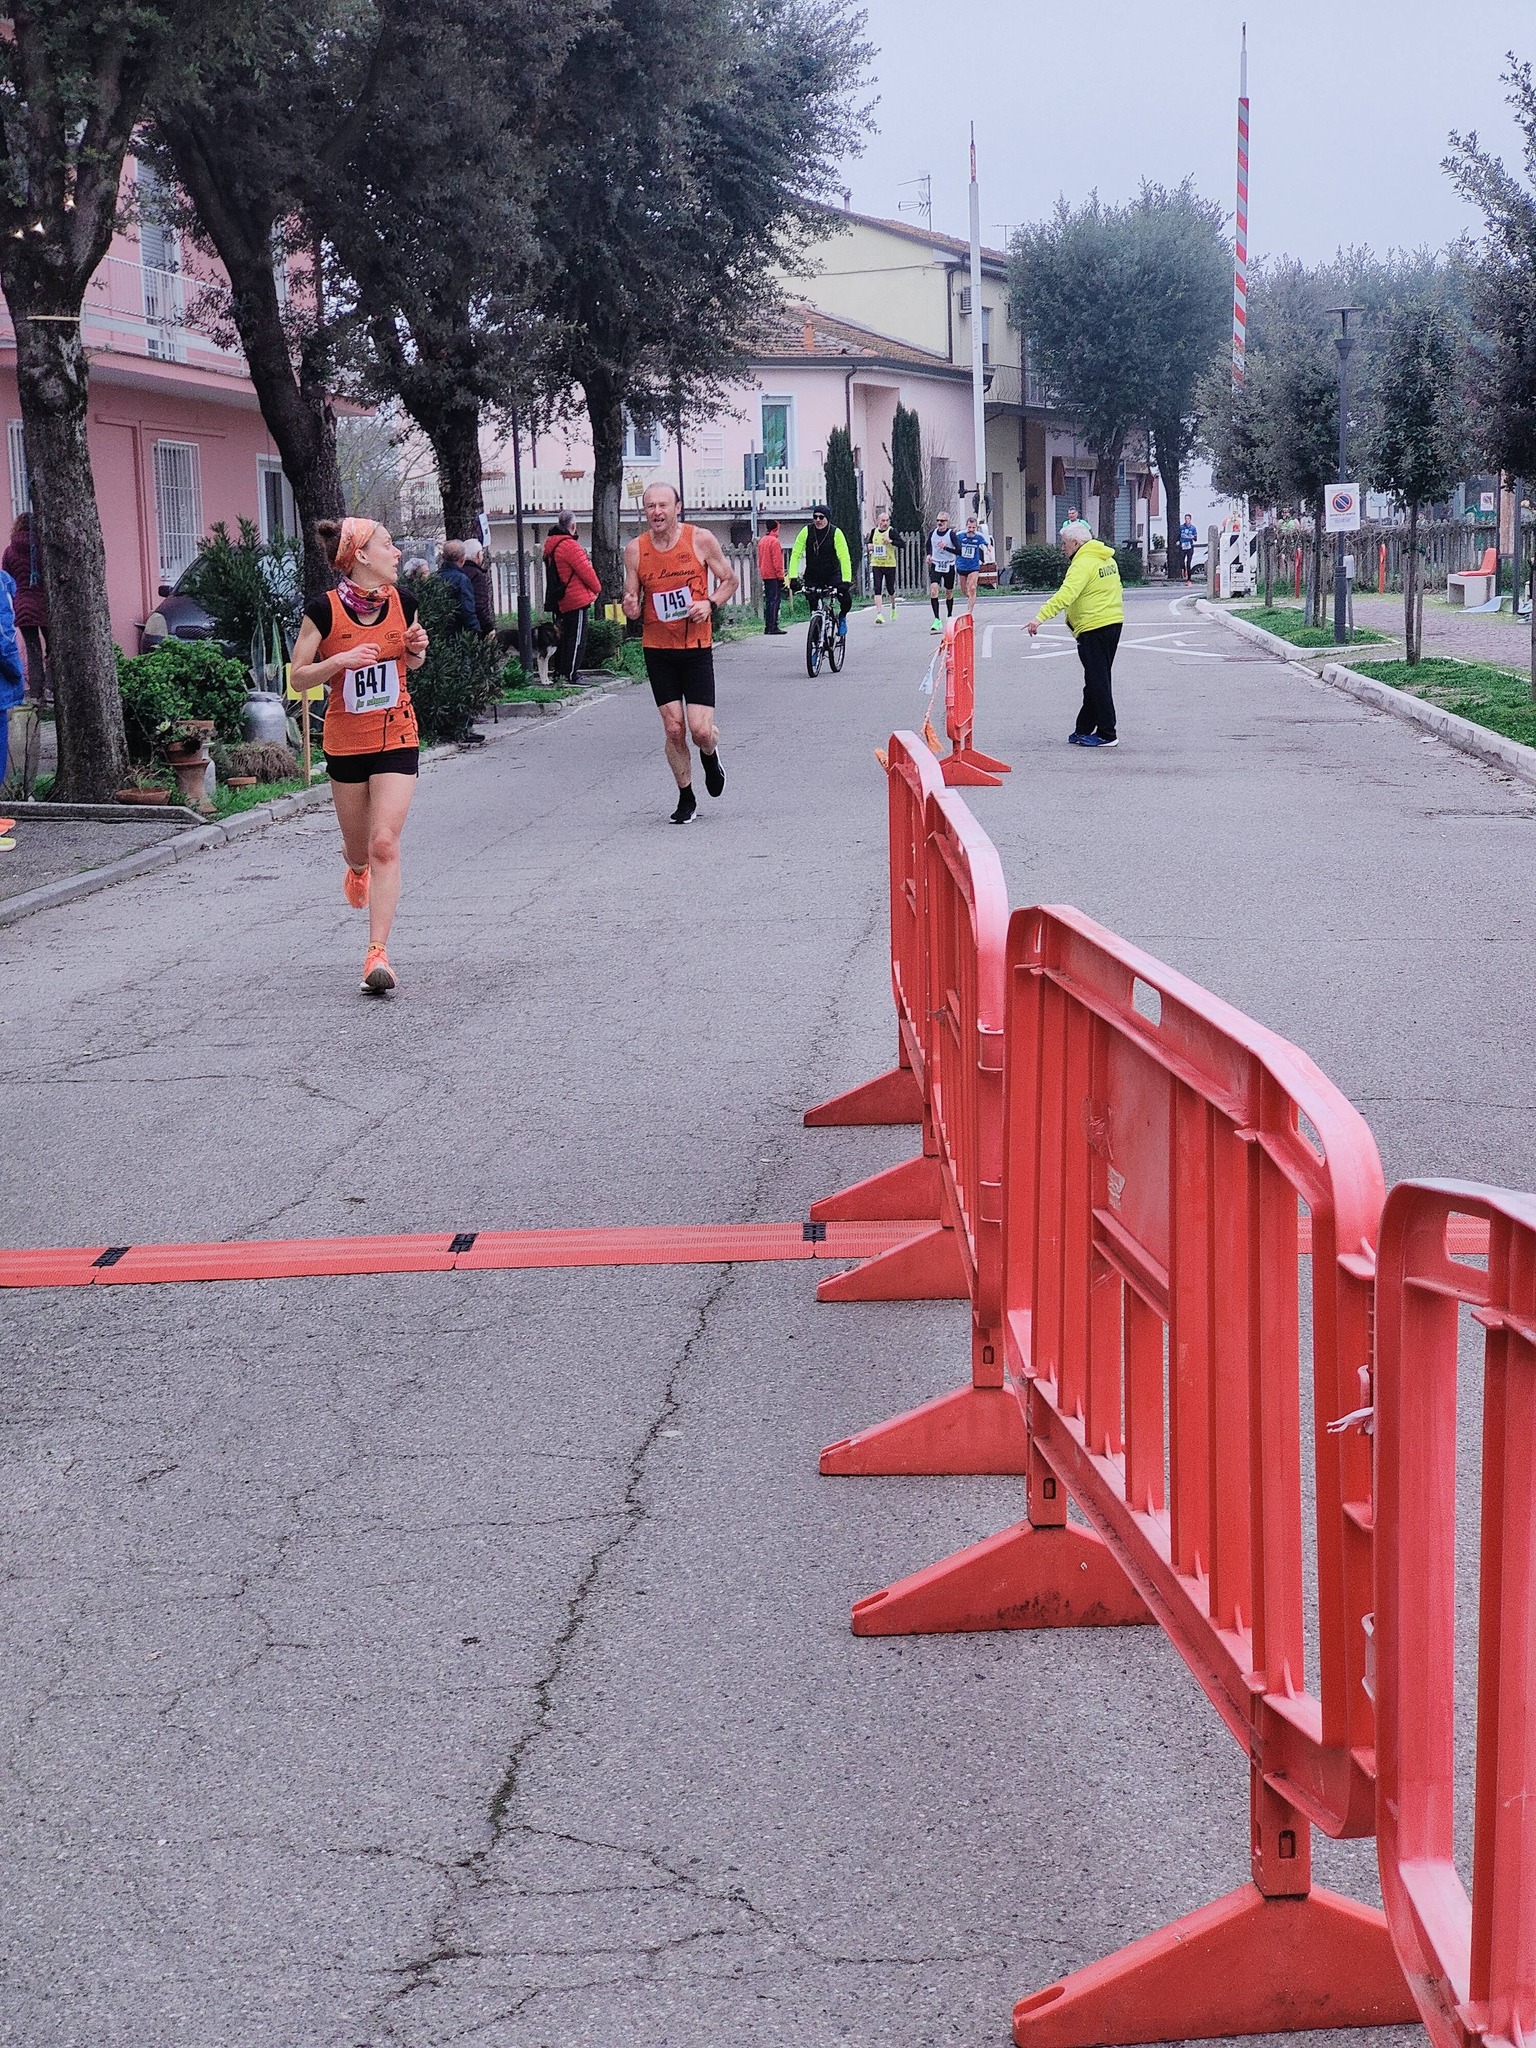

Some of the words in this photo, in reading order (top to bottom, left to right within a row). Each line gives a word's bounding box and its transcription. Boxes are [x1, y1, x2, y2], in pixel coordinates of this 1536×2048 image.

[658, 569, 695, 579] Lamone
[661, 590, 686, 611] 745
[355, 664, 387, 698] 647
